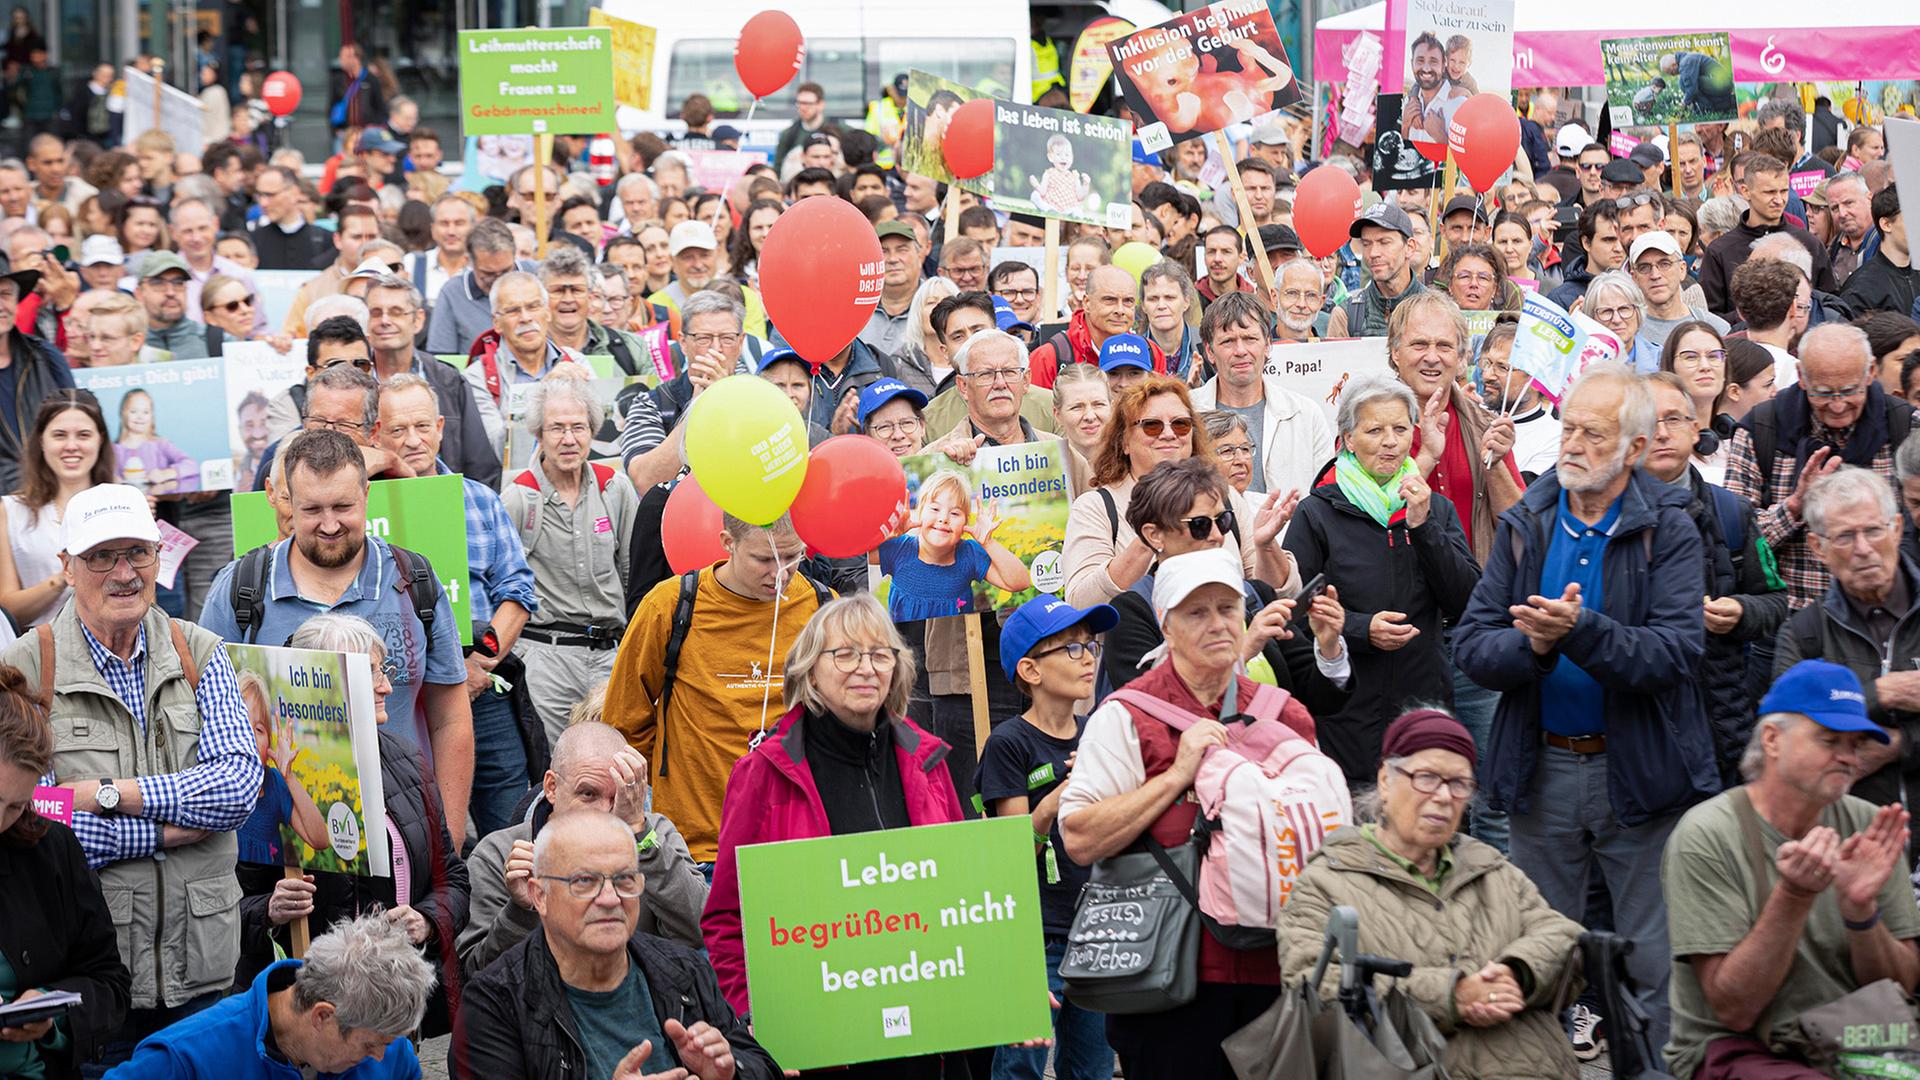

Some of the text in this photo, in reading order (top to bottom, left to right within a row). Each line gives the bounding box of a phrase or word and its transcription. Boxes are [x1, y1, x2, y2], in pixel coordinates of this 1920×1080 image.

[1415, 0, 1488, 18] Stolz darauf,
[1432, 14, 1506, 32] Vater zu sein
[469, 35, 602, 53] Leihmutterschaft
[1112, 24, 1192, 61] Inklusion
[1131, 20, 1259, 76] vor der Geburt
[1605, 36, 1725, 55] Menschenwürde kennt
[510, 59, 558, 73] macht
[1608, 52, 1659, 66] kein Alter
[499, 81, 577, 96] Frauen zu
[471, 100, 603, 118] Gebärmaschinen!
[997, 105, 1127, 142] Das Leben ist schön!
[859, 261, 875, 276] WIR
[858, 279, 875, 293] DAS
[1109, 343, 1141, 355] Kaleb
[88, 365, 219, 389] dass es Dich gibt!
[1286, 359, 1322, 376] Papa!
[997, 453, 1049, 473] Ich bin
[982, 474, 1067, 500] besonders!
[289, 664, 332, 689] Ich bin
[278, 697, 348, 723] besonders!
[33, 798, 65, 815] MME
[840, 851, 938, 889] Leben
[769, 890, 1017, 949] begrüßen, nicht
[1081, 902, 1143, 928] Jesus
[821, 946, 966, 993] beenden!
[1843, 1022, 1908, 1049] BERLIN
